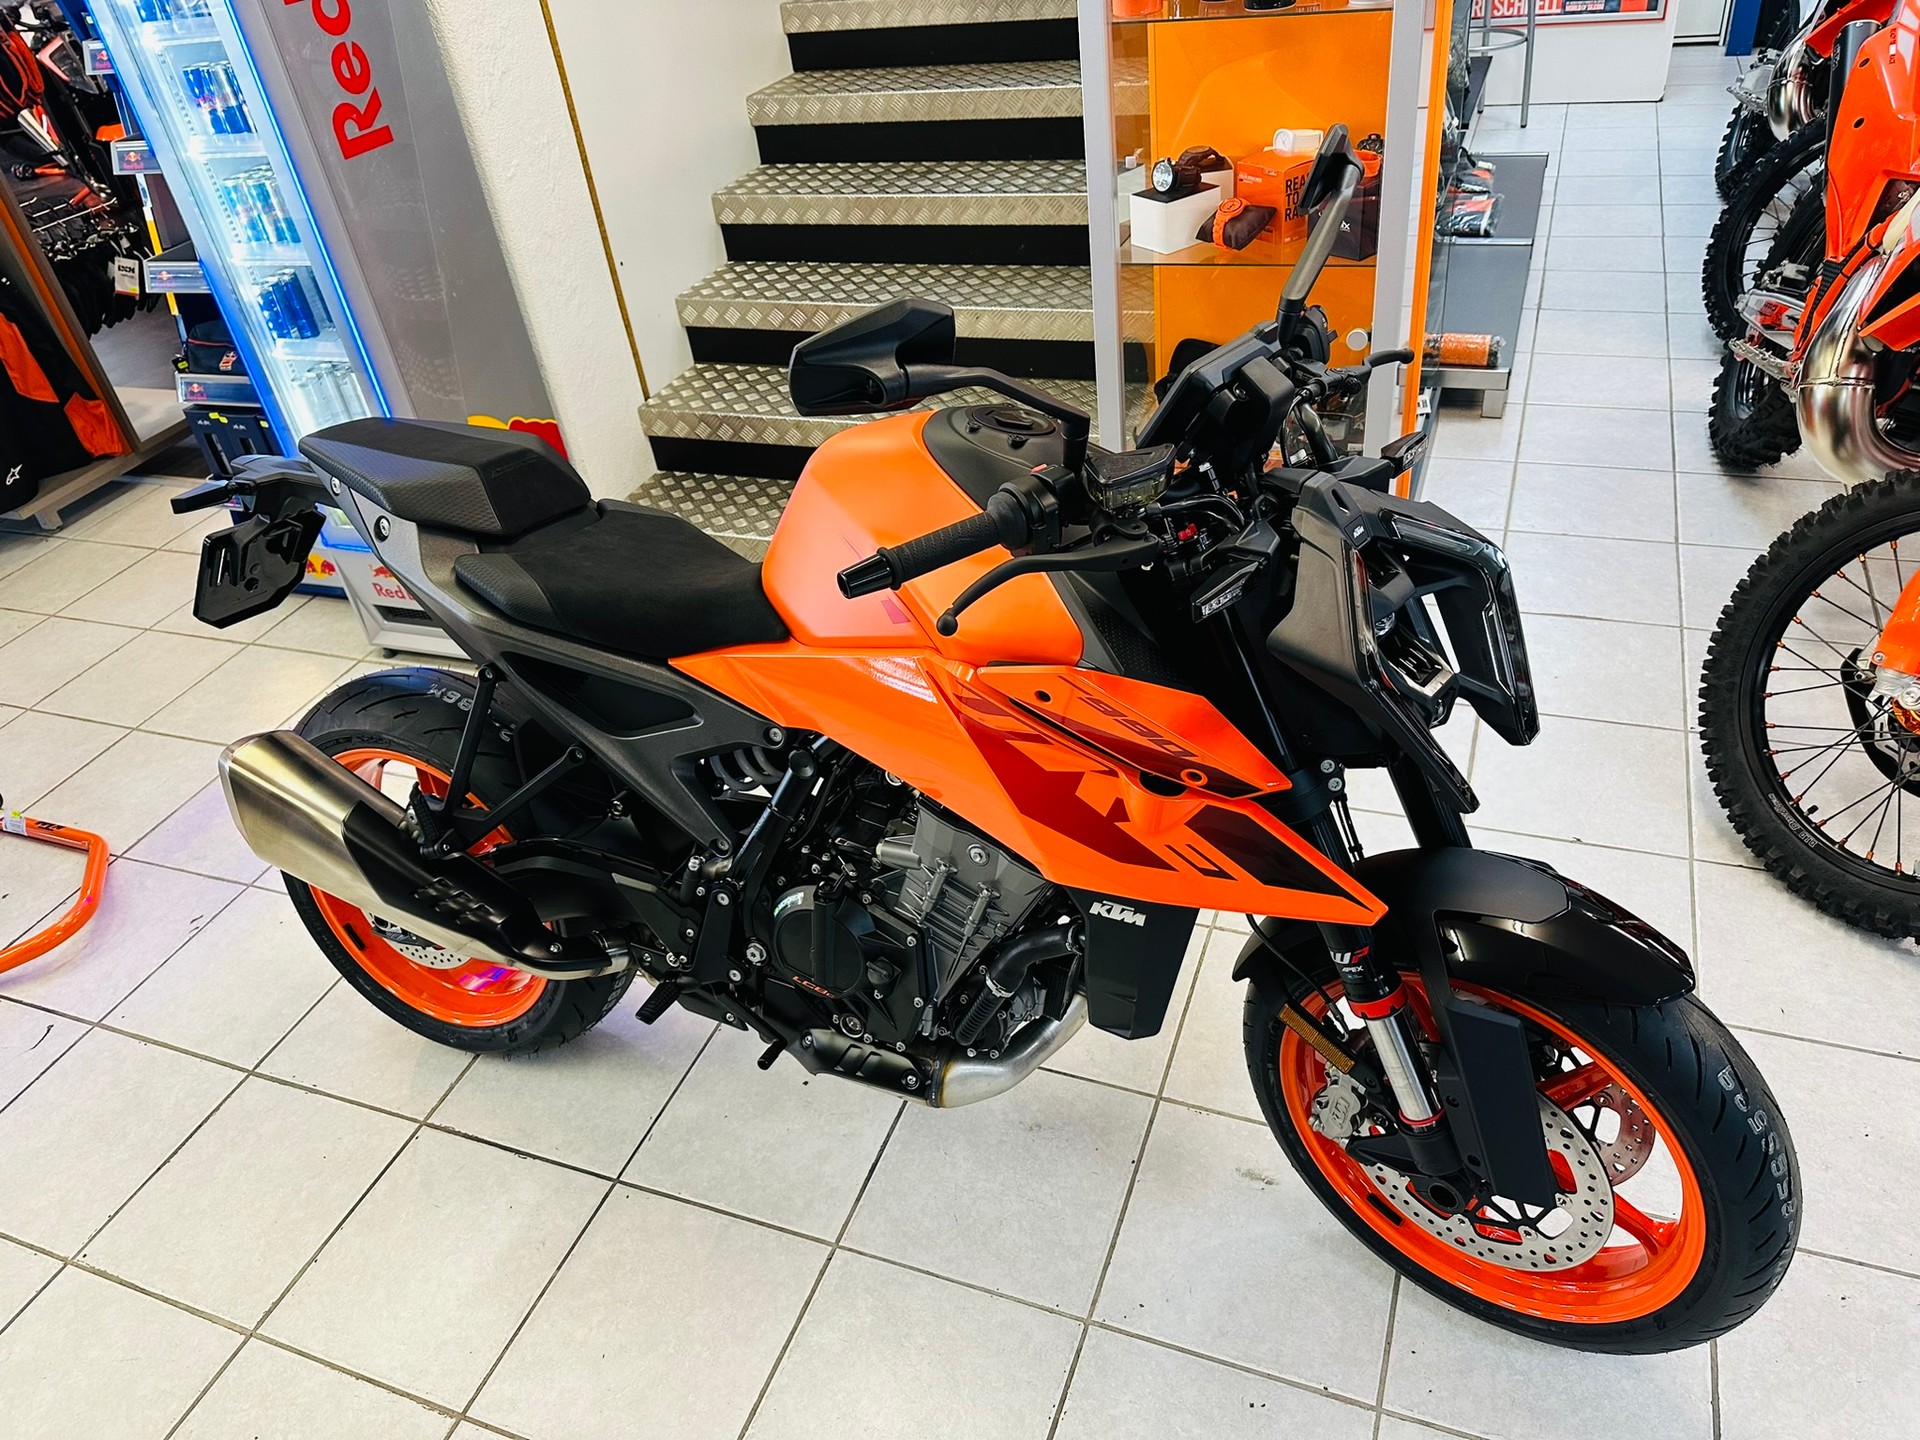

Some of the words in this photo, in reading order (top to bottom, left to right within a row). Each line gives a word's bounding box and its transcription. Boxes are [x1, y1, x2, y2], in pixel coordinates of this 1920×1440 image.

[283, 0, 394, 161] Red
[1285, 173, 1310, 194] REA
[1286, 191, 1299, 206] TO
[1284, 206, 1303, 222] RA
[372, 582, 406, 600] Red
[1088, 900, 1147, 927] KTM
[1341, 965, 1364, 973] APEX
